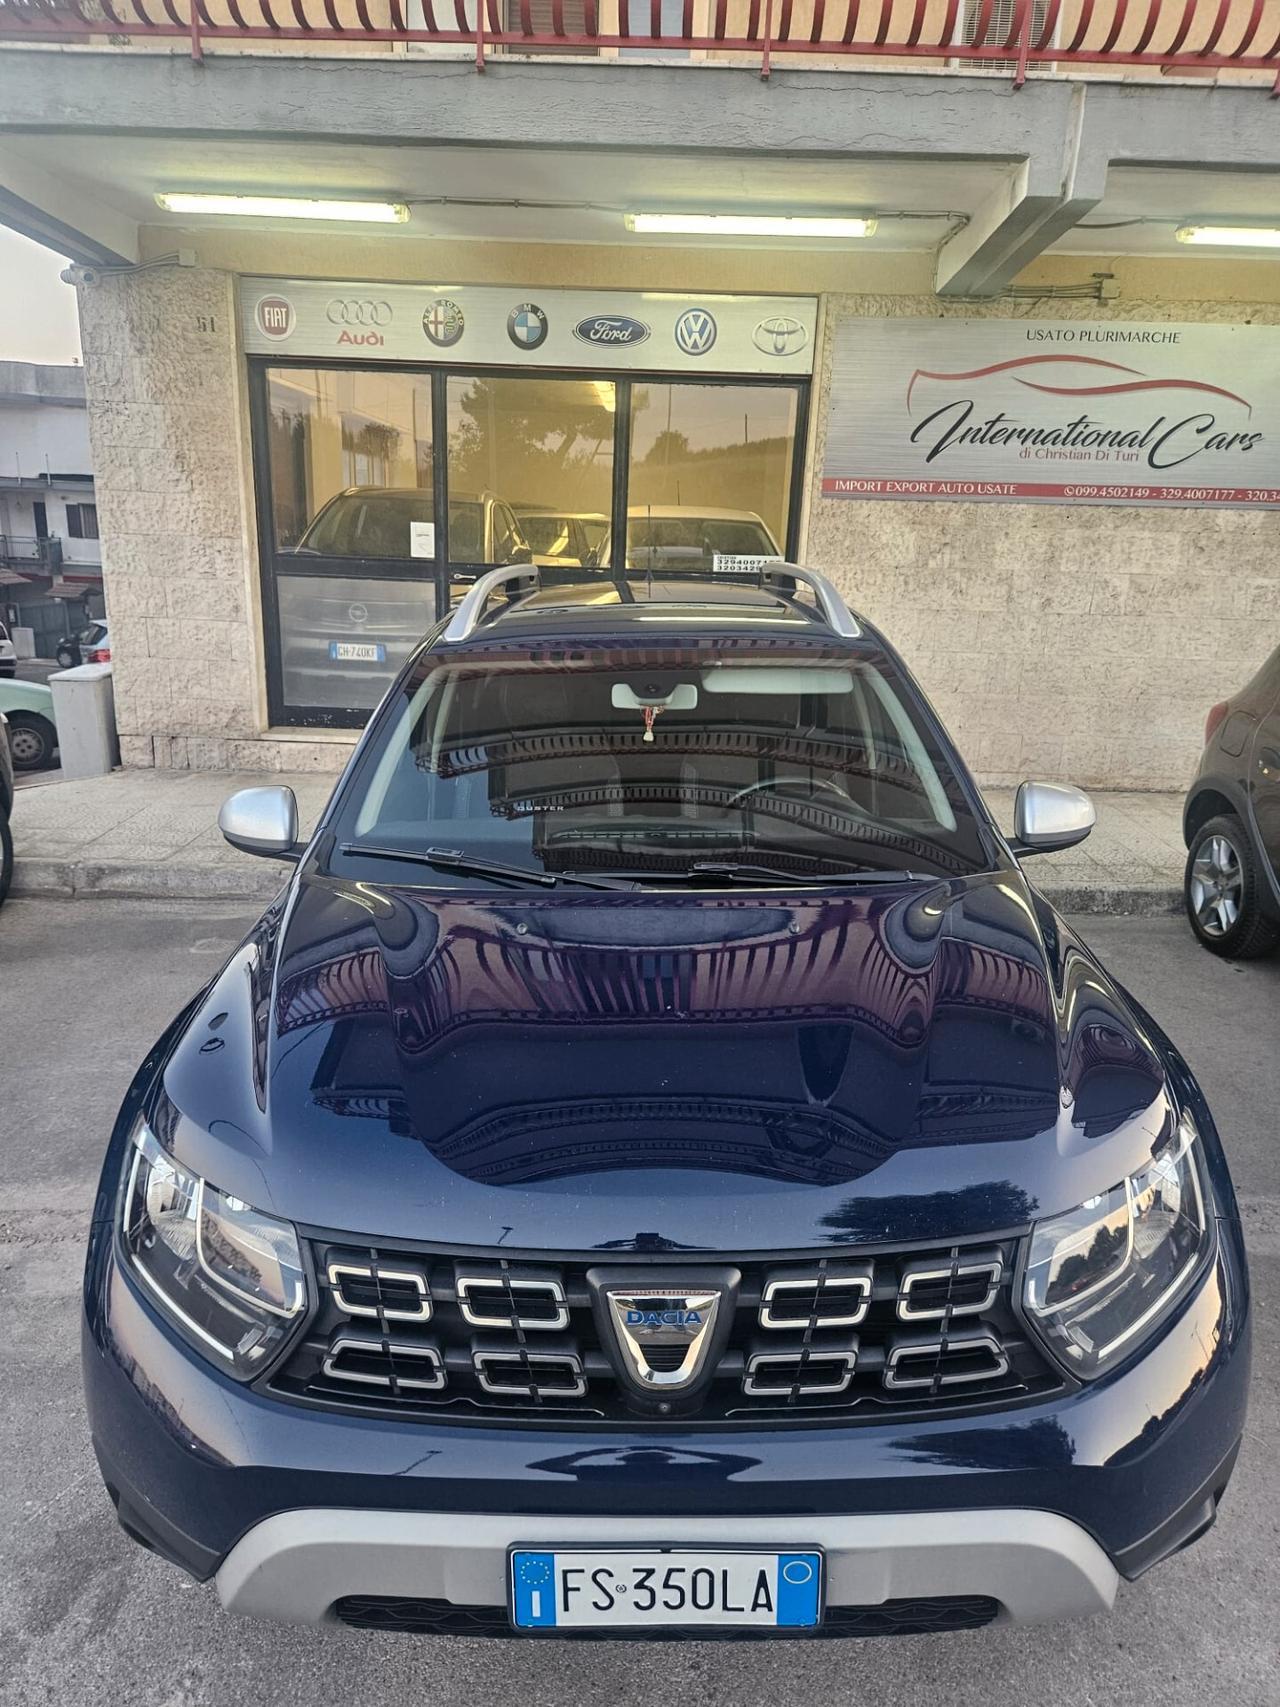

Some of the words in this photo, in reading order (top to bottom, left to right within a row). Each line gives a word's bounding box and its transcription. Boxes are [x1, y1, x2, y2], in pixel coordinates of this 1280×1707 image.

[264, 307, 287, 328] FIAT
[337, 330, 384, 346] Audi
[590, 319, 633, 341] Ford
[1026, 329, 1075, 343] USATO
[1079, 331, 1181, 345] PLURIMARCHE
[910, 399, 1168, 464] International
[1147, 413, 1266, 470] Cars
[1019, 448, 1032, 460] di
[1035, 448, 1091, 461] Christian
[1095, 449, 1110, 461] Di
[1114, 449, 1140, 462] Turi
[835, 480, 883, 492] IMPORT
[886, 481, 935, 493] EXPORT
[938, 483, 974, 494] AUTO
[977, 484, 1018, 495] USATE
[1075, 486, 1150, 498] 099.4502149
[1160, 488, 1236, 500] 329.4007177
[626, 1311, 702, 1326] DACIA
